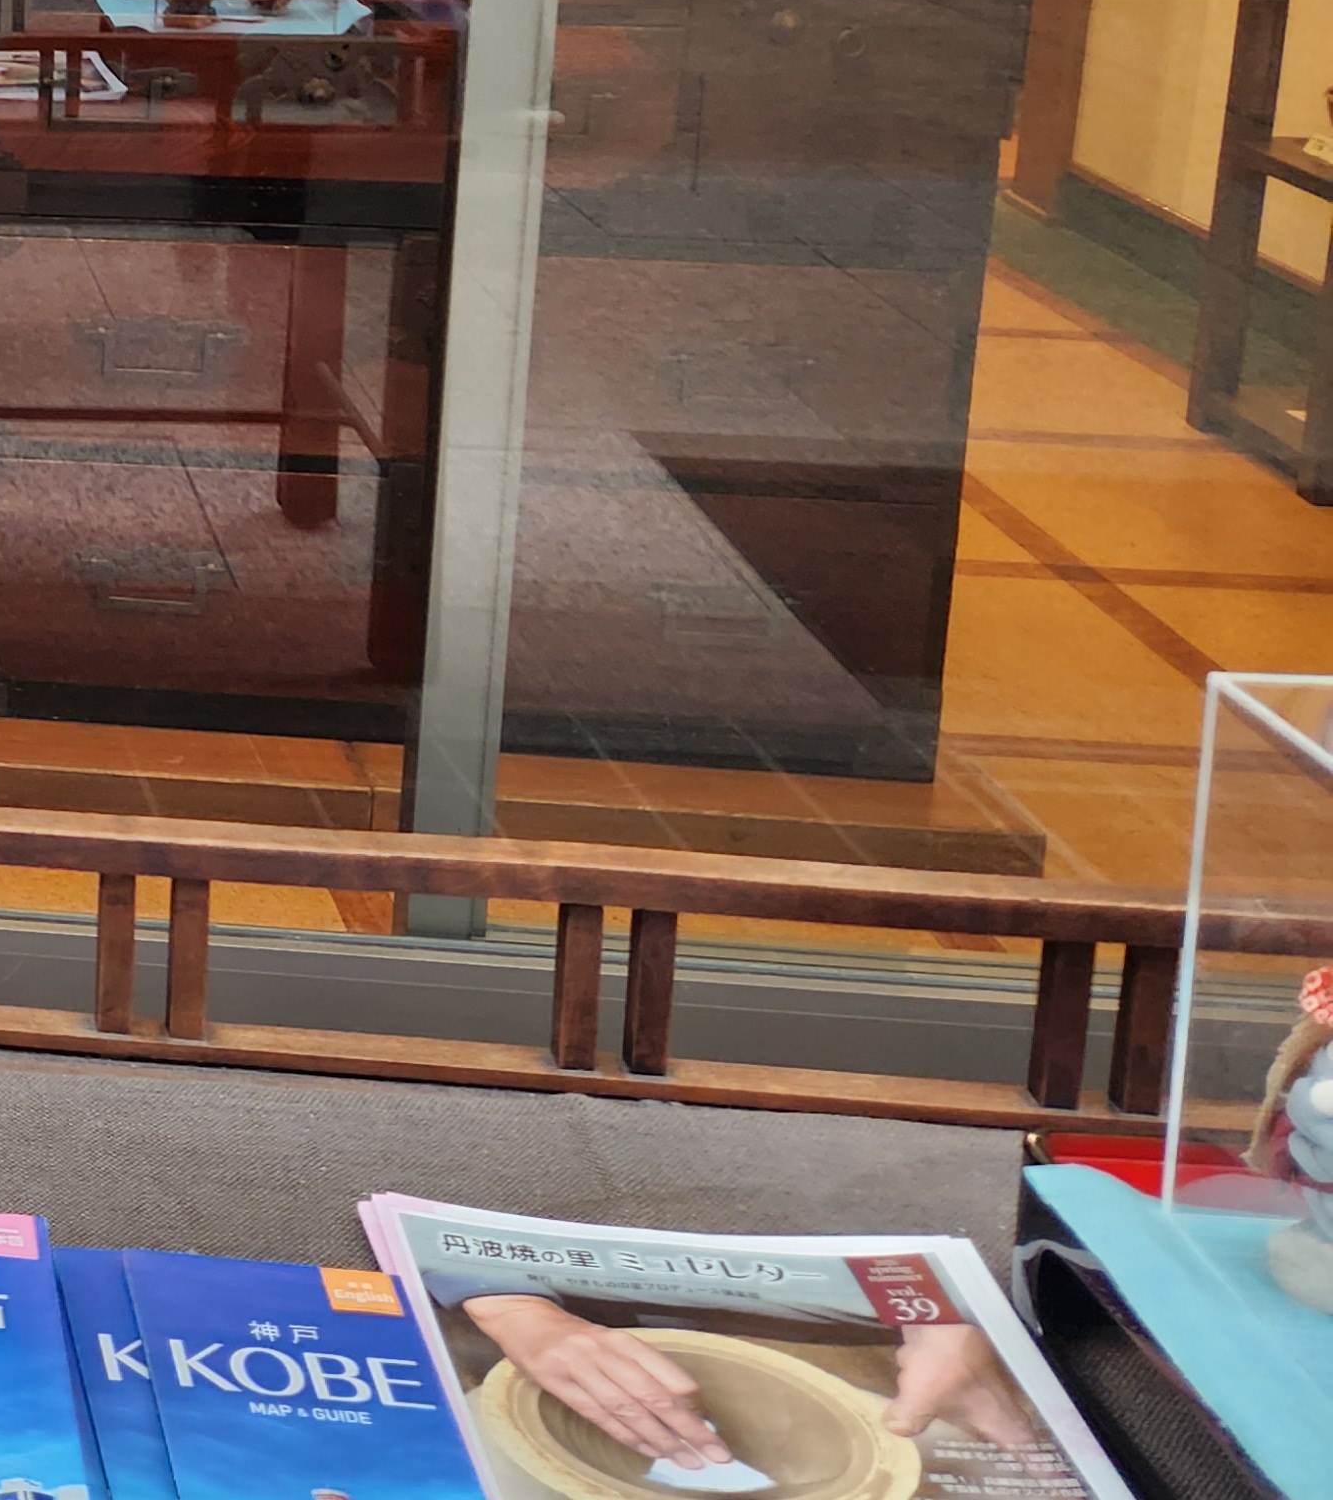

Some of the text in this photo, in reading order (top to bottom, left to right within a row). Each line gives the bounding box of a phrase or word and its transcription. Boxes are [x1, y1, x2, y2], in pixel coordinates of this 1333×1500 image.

[441, 1232, 601, 1270] 丹波焼の里
[333, 1289, 395, 1304] English
[887, 1285, 923, 1297] vol.
[888, 1298, 940, 1321] 39
[248, 1320, 320, 1344] 神戸
[169, 1338, 437, 1411] KOBE
[249, 1401, 373, 1425] MAP & GUIDE
